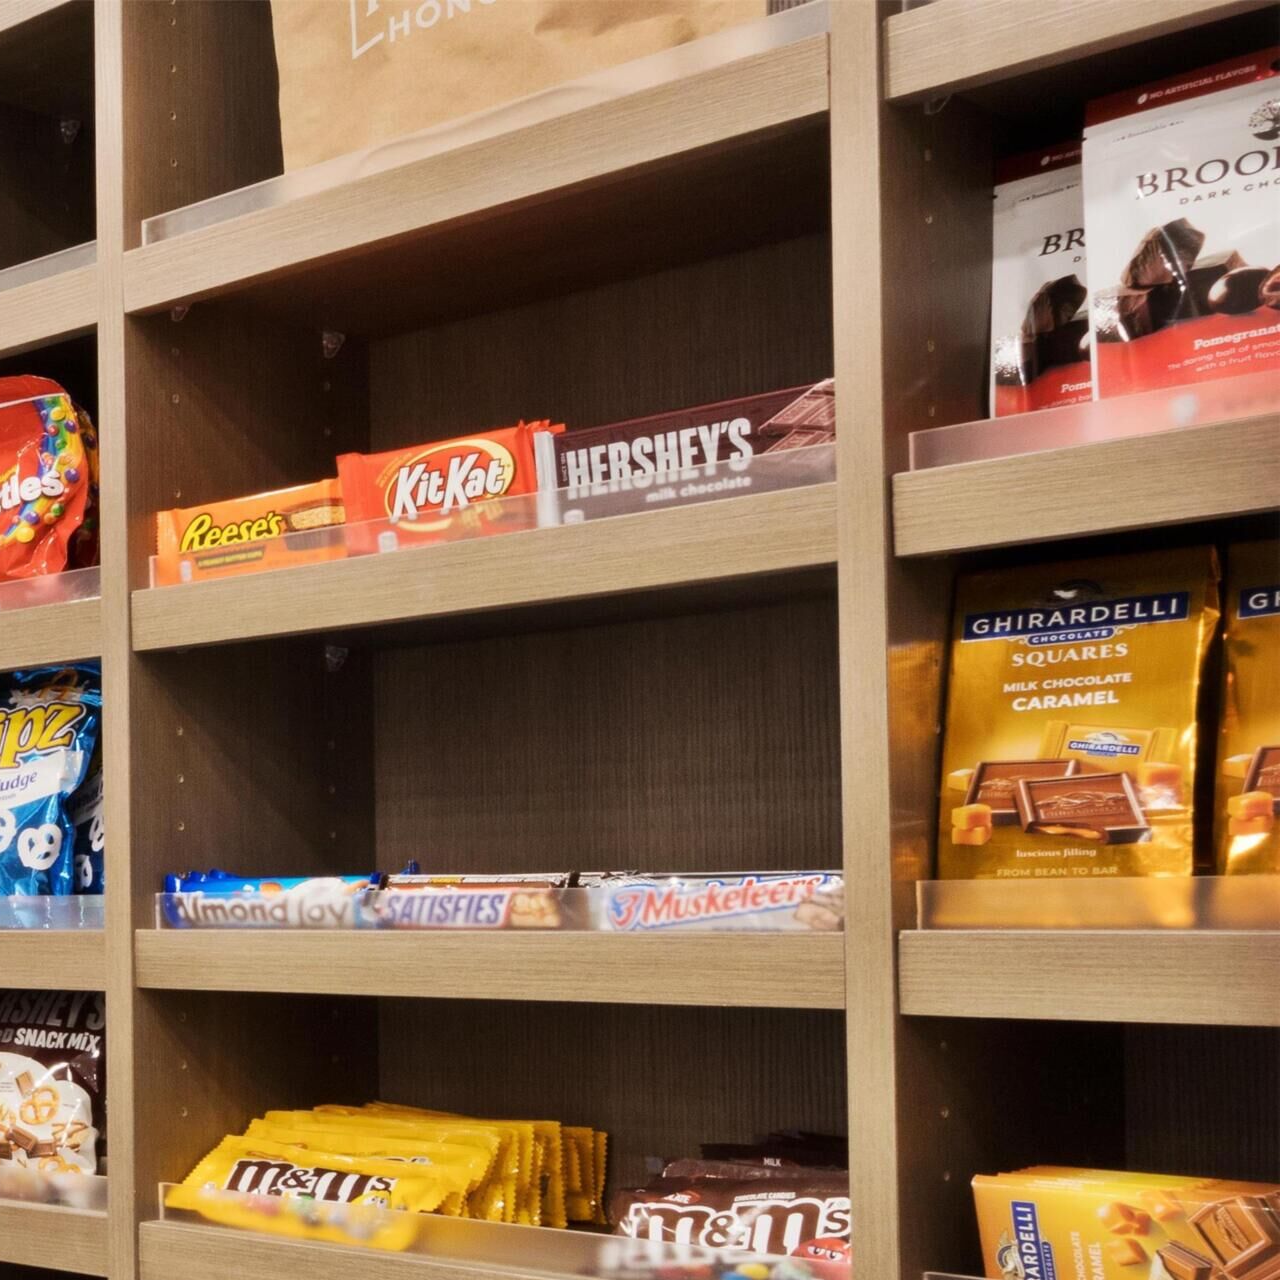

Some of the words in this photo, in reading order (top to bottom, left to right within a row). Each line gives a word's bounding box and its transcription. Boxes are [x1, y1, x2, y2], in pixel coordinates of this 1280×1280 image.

[1178, 186, 1232, 206] DARK
[566, 416, 754, 501] HERSHEY'S
[646, 487, 677, 503] milk
[679, 475, 752, 498] chocolate
[971, 597, 1180, 636] GHIRARDELLI
[1031, 628, 1110, 645] CHOCOLATE
[1010, 642, 1129, 669] SQUARES
[1002, 679, 1039, 694] MILK
[1042, 672, 1133, 690] CHOCOLATE
[1011, 689, 1120, 712] CARAMEL
[996, 867, 1031, 878] FROM
[1034, 866, 1068, 877] BEAN
[1072, 866, 1089, 876] TO
[1092, 865, 1119, 876] BAR
[384, 892, 507, 929] SATISFIES
[641, 873, 821, 927] Musketeers
[14, 1026, 68, 1050] SNACK
